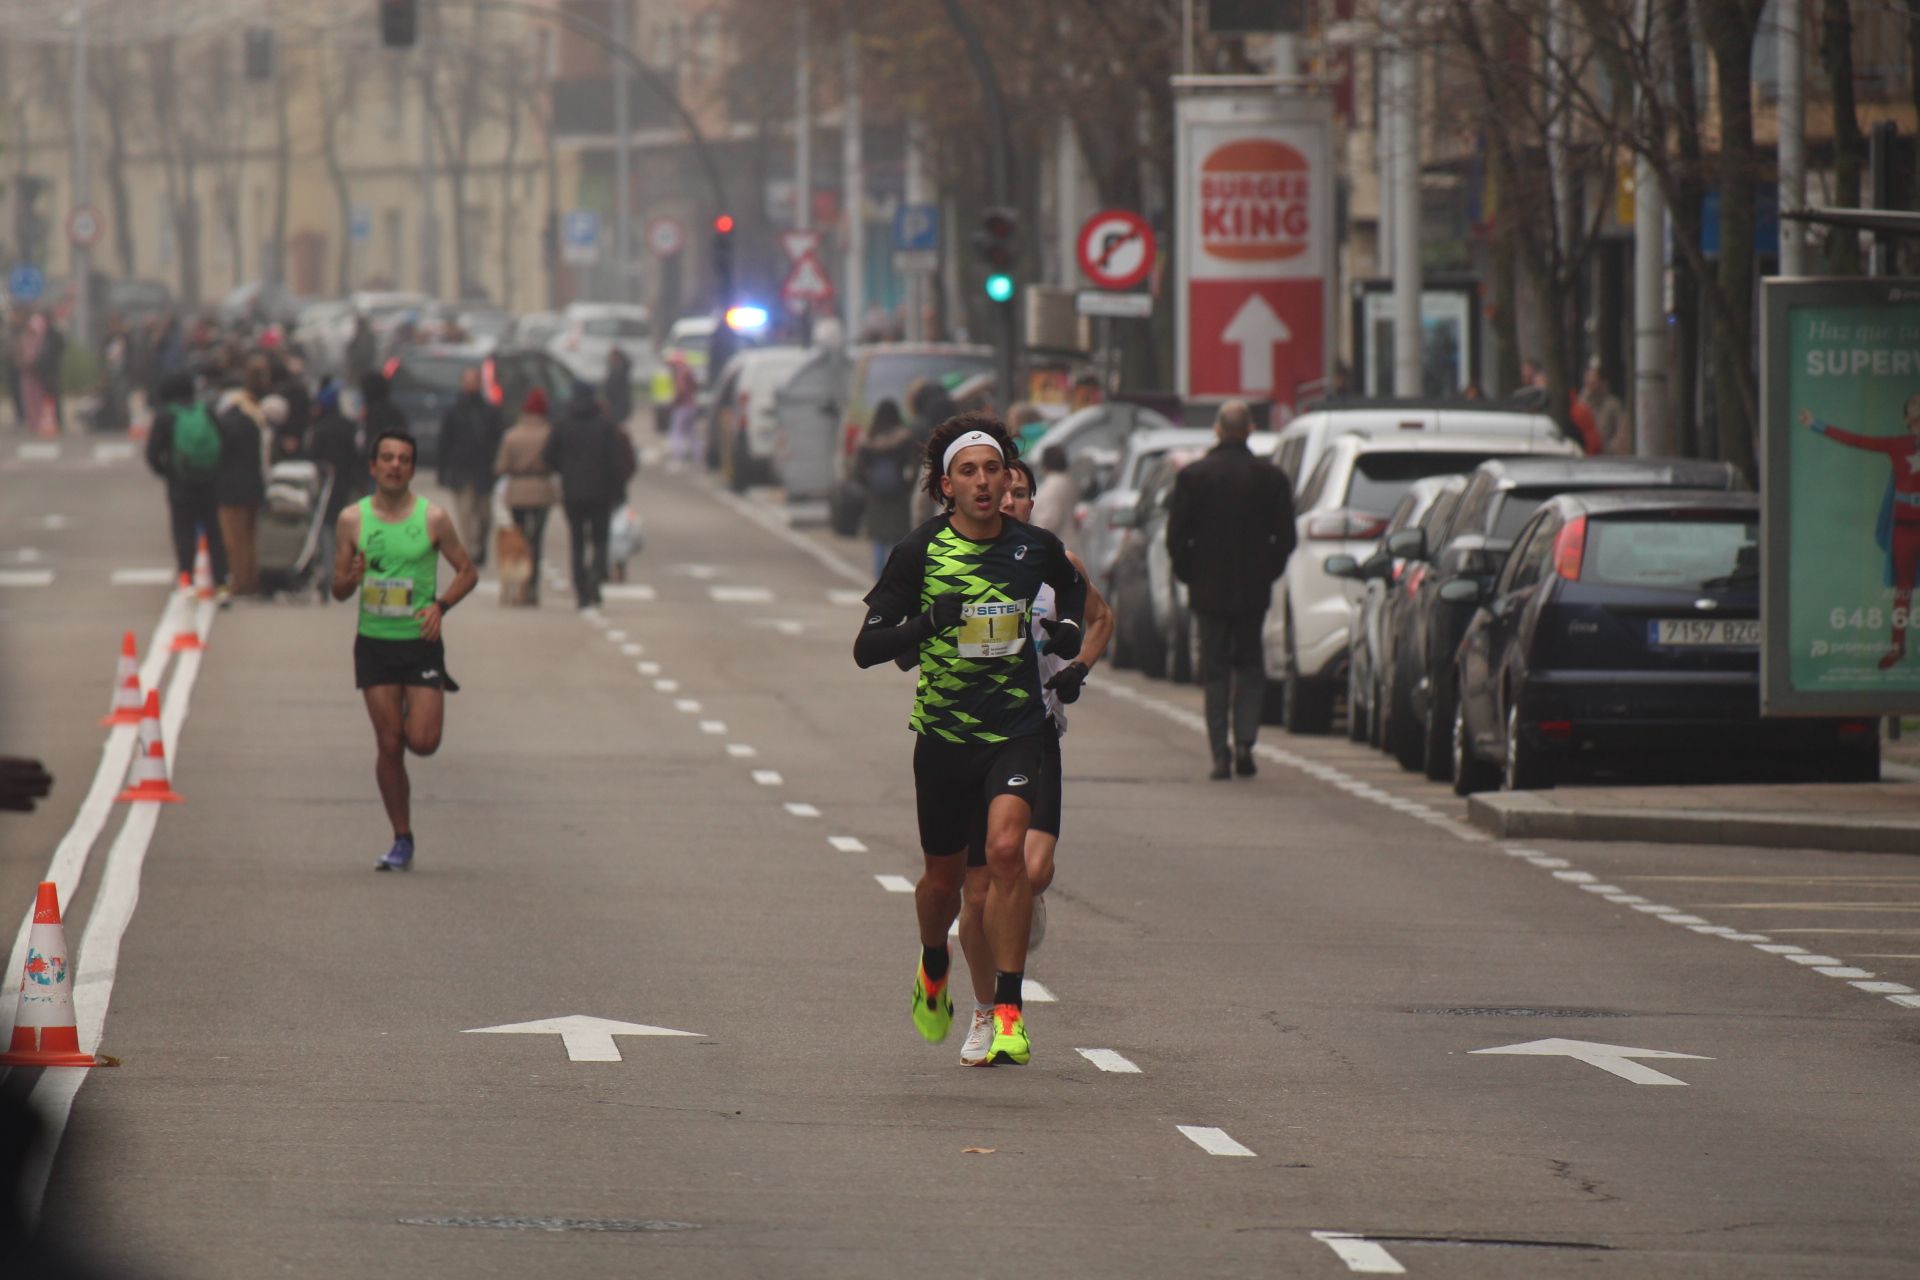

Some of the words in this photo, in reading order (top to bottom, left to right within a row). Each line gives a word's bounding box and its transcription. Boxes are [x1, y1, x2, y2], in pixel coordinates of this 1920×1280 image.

[1202, 177, 1309, 199] BURGER
[1202, 202, 1310, 237] KING
[977, 604, 1020, 616] SETEL
[1830, 606, 1883, 629] 648
[988, 617, 994, 638] 1
[1666, 621, 1716, 641] 7157
